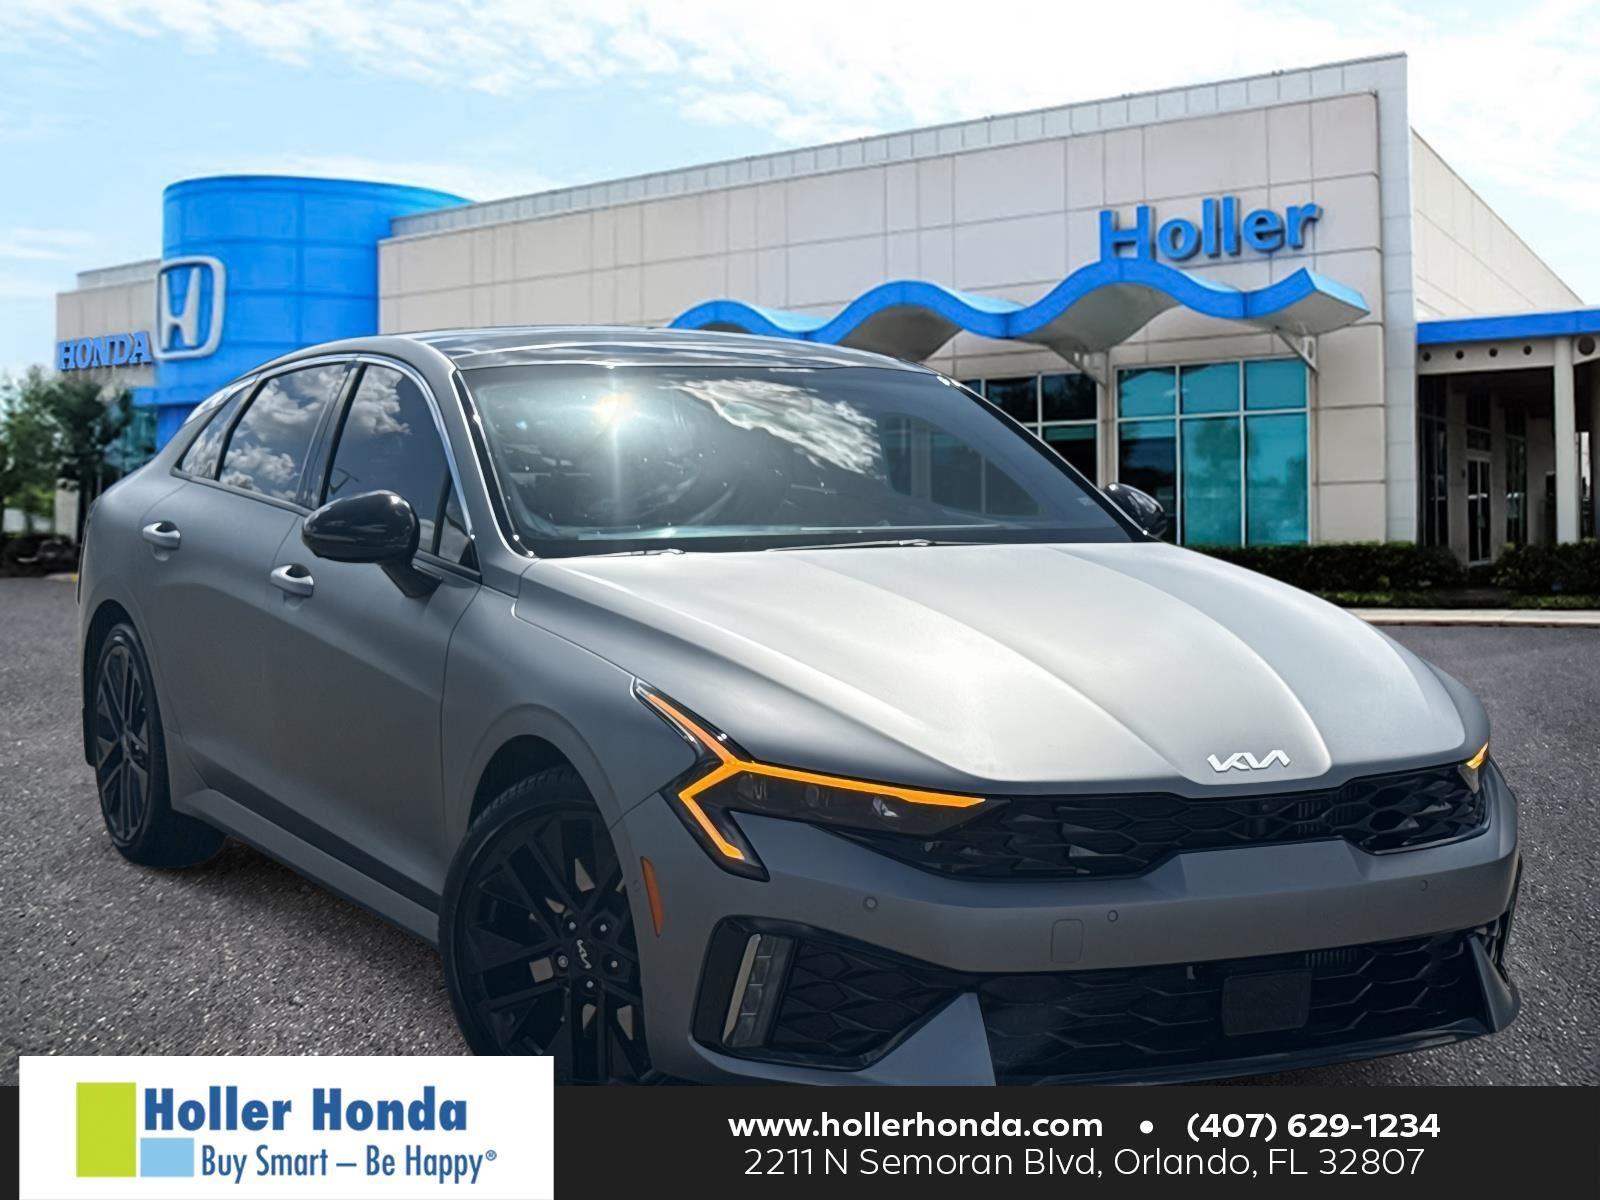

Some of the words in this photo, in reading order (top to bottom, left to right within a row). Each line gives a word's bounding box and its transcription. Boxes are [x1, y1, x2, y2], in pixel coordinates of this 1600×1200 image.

[1099, 195, 1322, 262] Holler
[57, 331, 153, 371] HONDA
[1207, 749, 1291, 773] KIA
